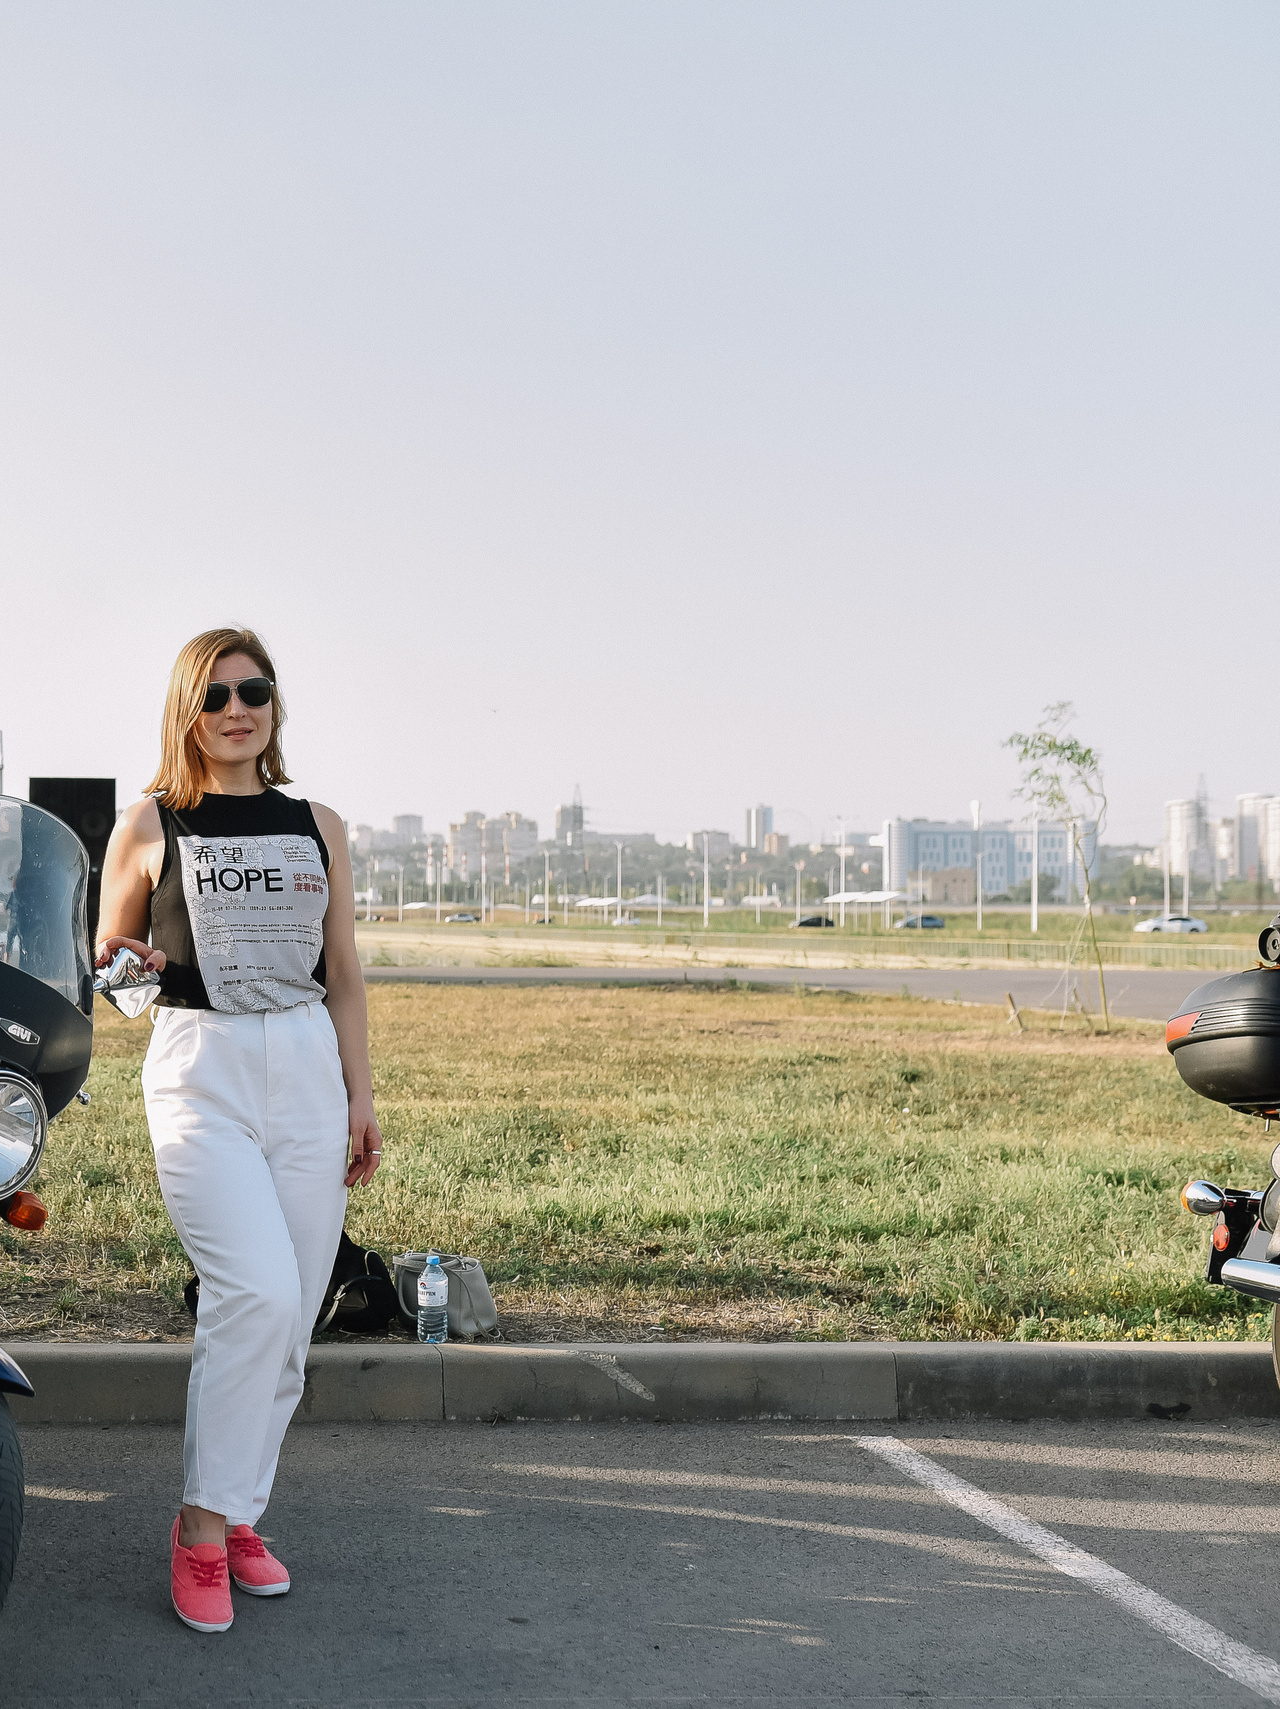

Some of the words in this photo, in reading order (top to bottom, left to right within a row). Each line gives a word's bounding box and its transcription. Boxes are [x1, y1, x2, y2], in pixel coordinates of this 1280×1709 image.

[193, 845, 247, 865] 希望
[195, 868, 284, 895] HOPE
[7, 1024, 32, 1042] GIVI
